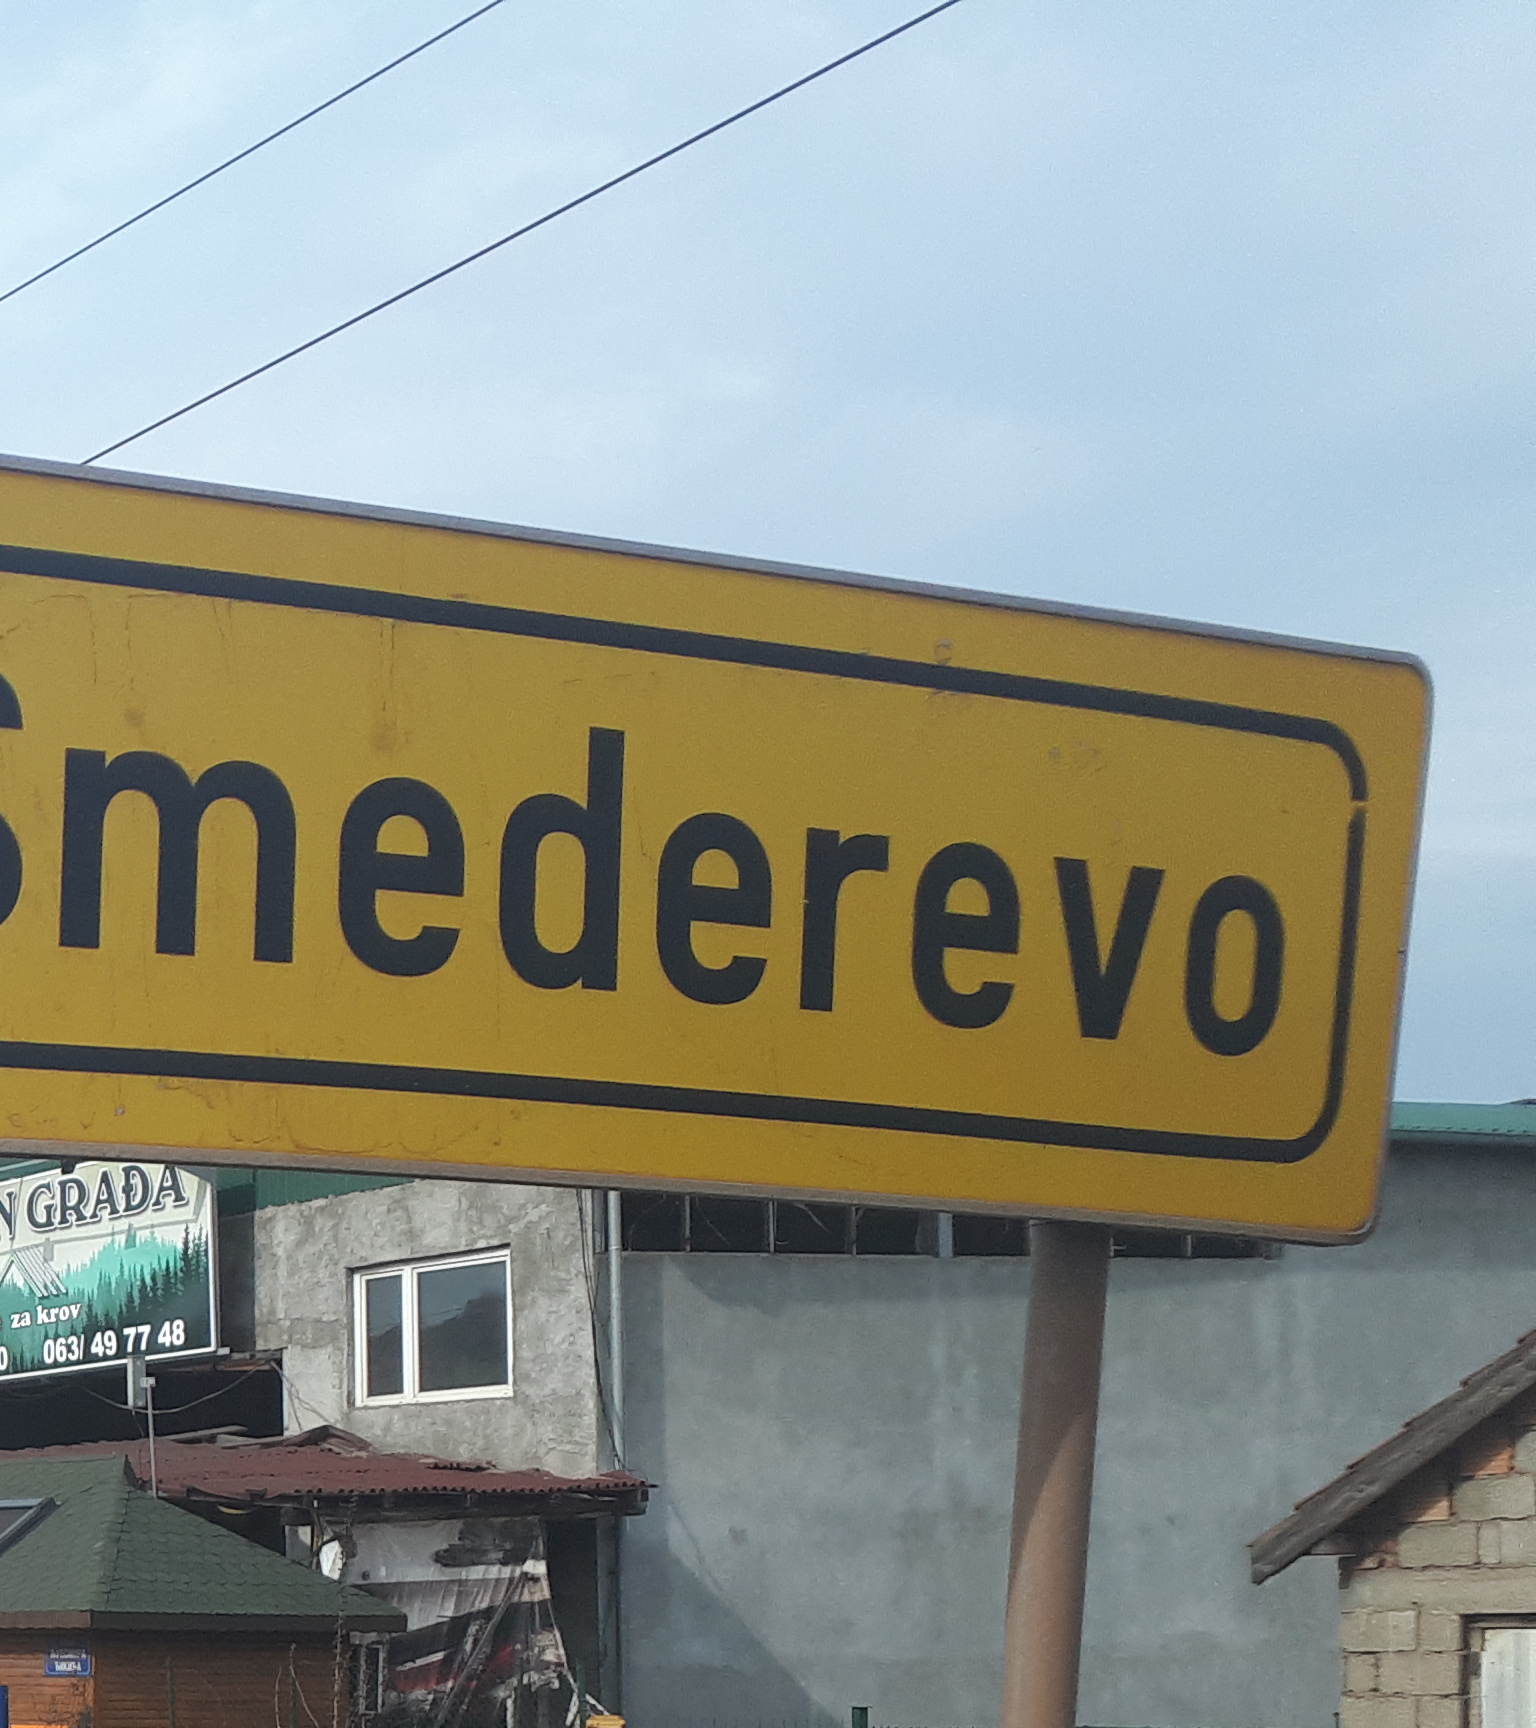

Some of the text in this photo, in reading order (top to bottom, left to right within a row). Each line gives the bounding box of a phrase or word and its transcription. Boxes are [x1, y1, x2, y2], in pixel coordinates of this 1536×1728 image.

[27, 1163, 188, 1231] GRAĐA
[10, 1310, 32, 1329] za
[36, 1302, 82, 1324] krov
[42, 1334, 85, 1365] 063/
[90, 1329, 118, 1357] 49
[123, 1324, 151, 1352] 77
[157, 1318, 186, 1348] 48
